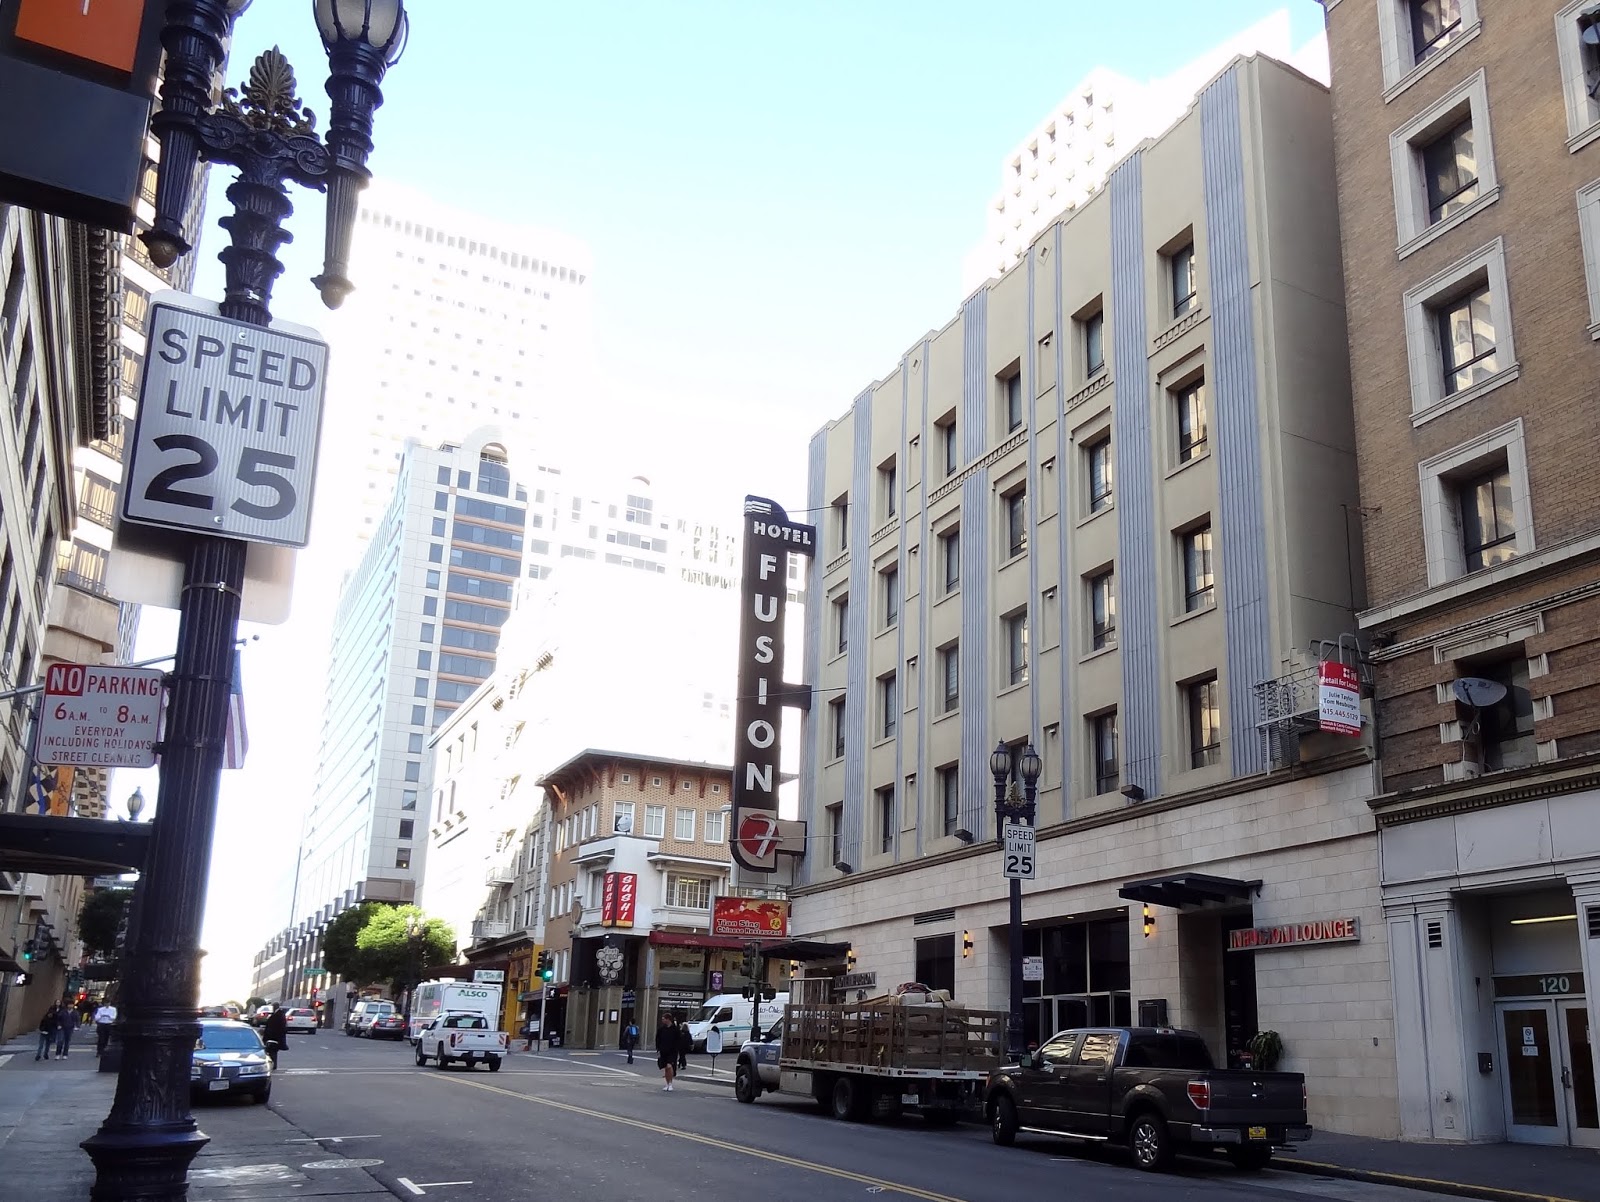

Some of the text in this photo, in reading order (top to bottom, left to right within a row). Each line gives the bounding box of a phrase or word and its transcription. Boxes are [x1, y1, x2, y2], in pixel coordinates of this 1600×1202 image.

[158, 328, 317, 392] SPEED
[166, 379, 299, 438] LIMIT
[144, 433, 297, 521] 25
[753, 520, 812, 546] HOTEL
[745, 553, 778, 793] FUSION
[50, 667, 159, 697] NO PARKING
[1320, 676, 1339, 685] Retail
[1346, 680, 1358, 690] Lease
[99, 706, 108, 714] TO
[74, 725, 125, 738] EVERYDAY
[44, 736, 152, 750] INCLUDING HOLIDAYS
[52, 751, 141, 764] STREET CLEANING
[1007, 829, 1034, 841] SPEED
[1009, 841, 1031, 853] LIMIT
[1006, 854, 1033, 875] 25
[604, 874, 614, 920] SUSHI
[620, 875, 634, 920] SUSHI
[716, 926, 783, 936] Chinese Restaurant
[717, 918, 738, 927] Tian
[739, 919, 760, 928] Sing
[1295, 918, 1354, 942] LOUNGE
[1539, 976, 1570, 993] 120
[458, 989, 488, 998] ALSCO
